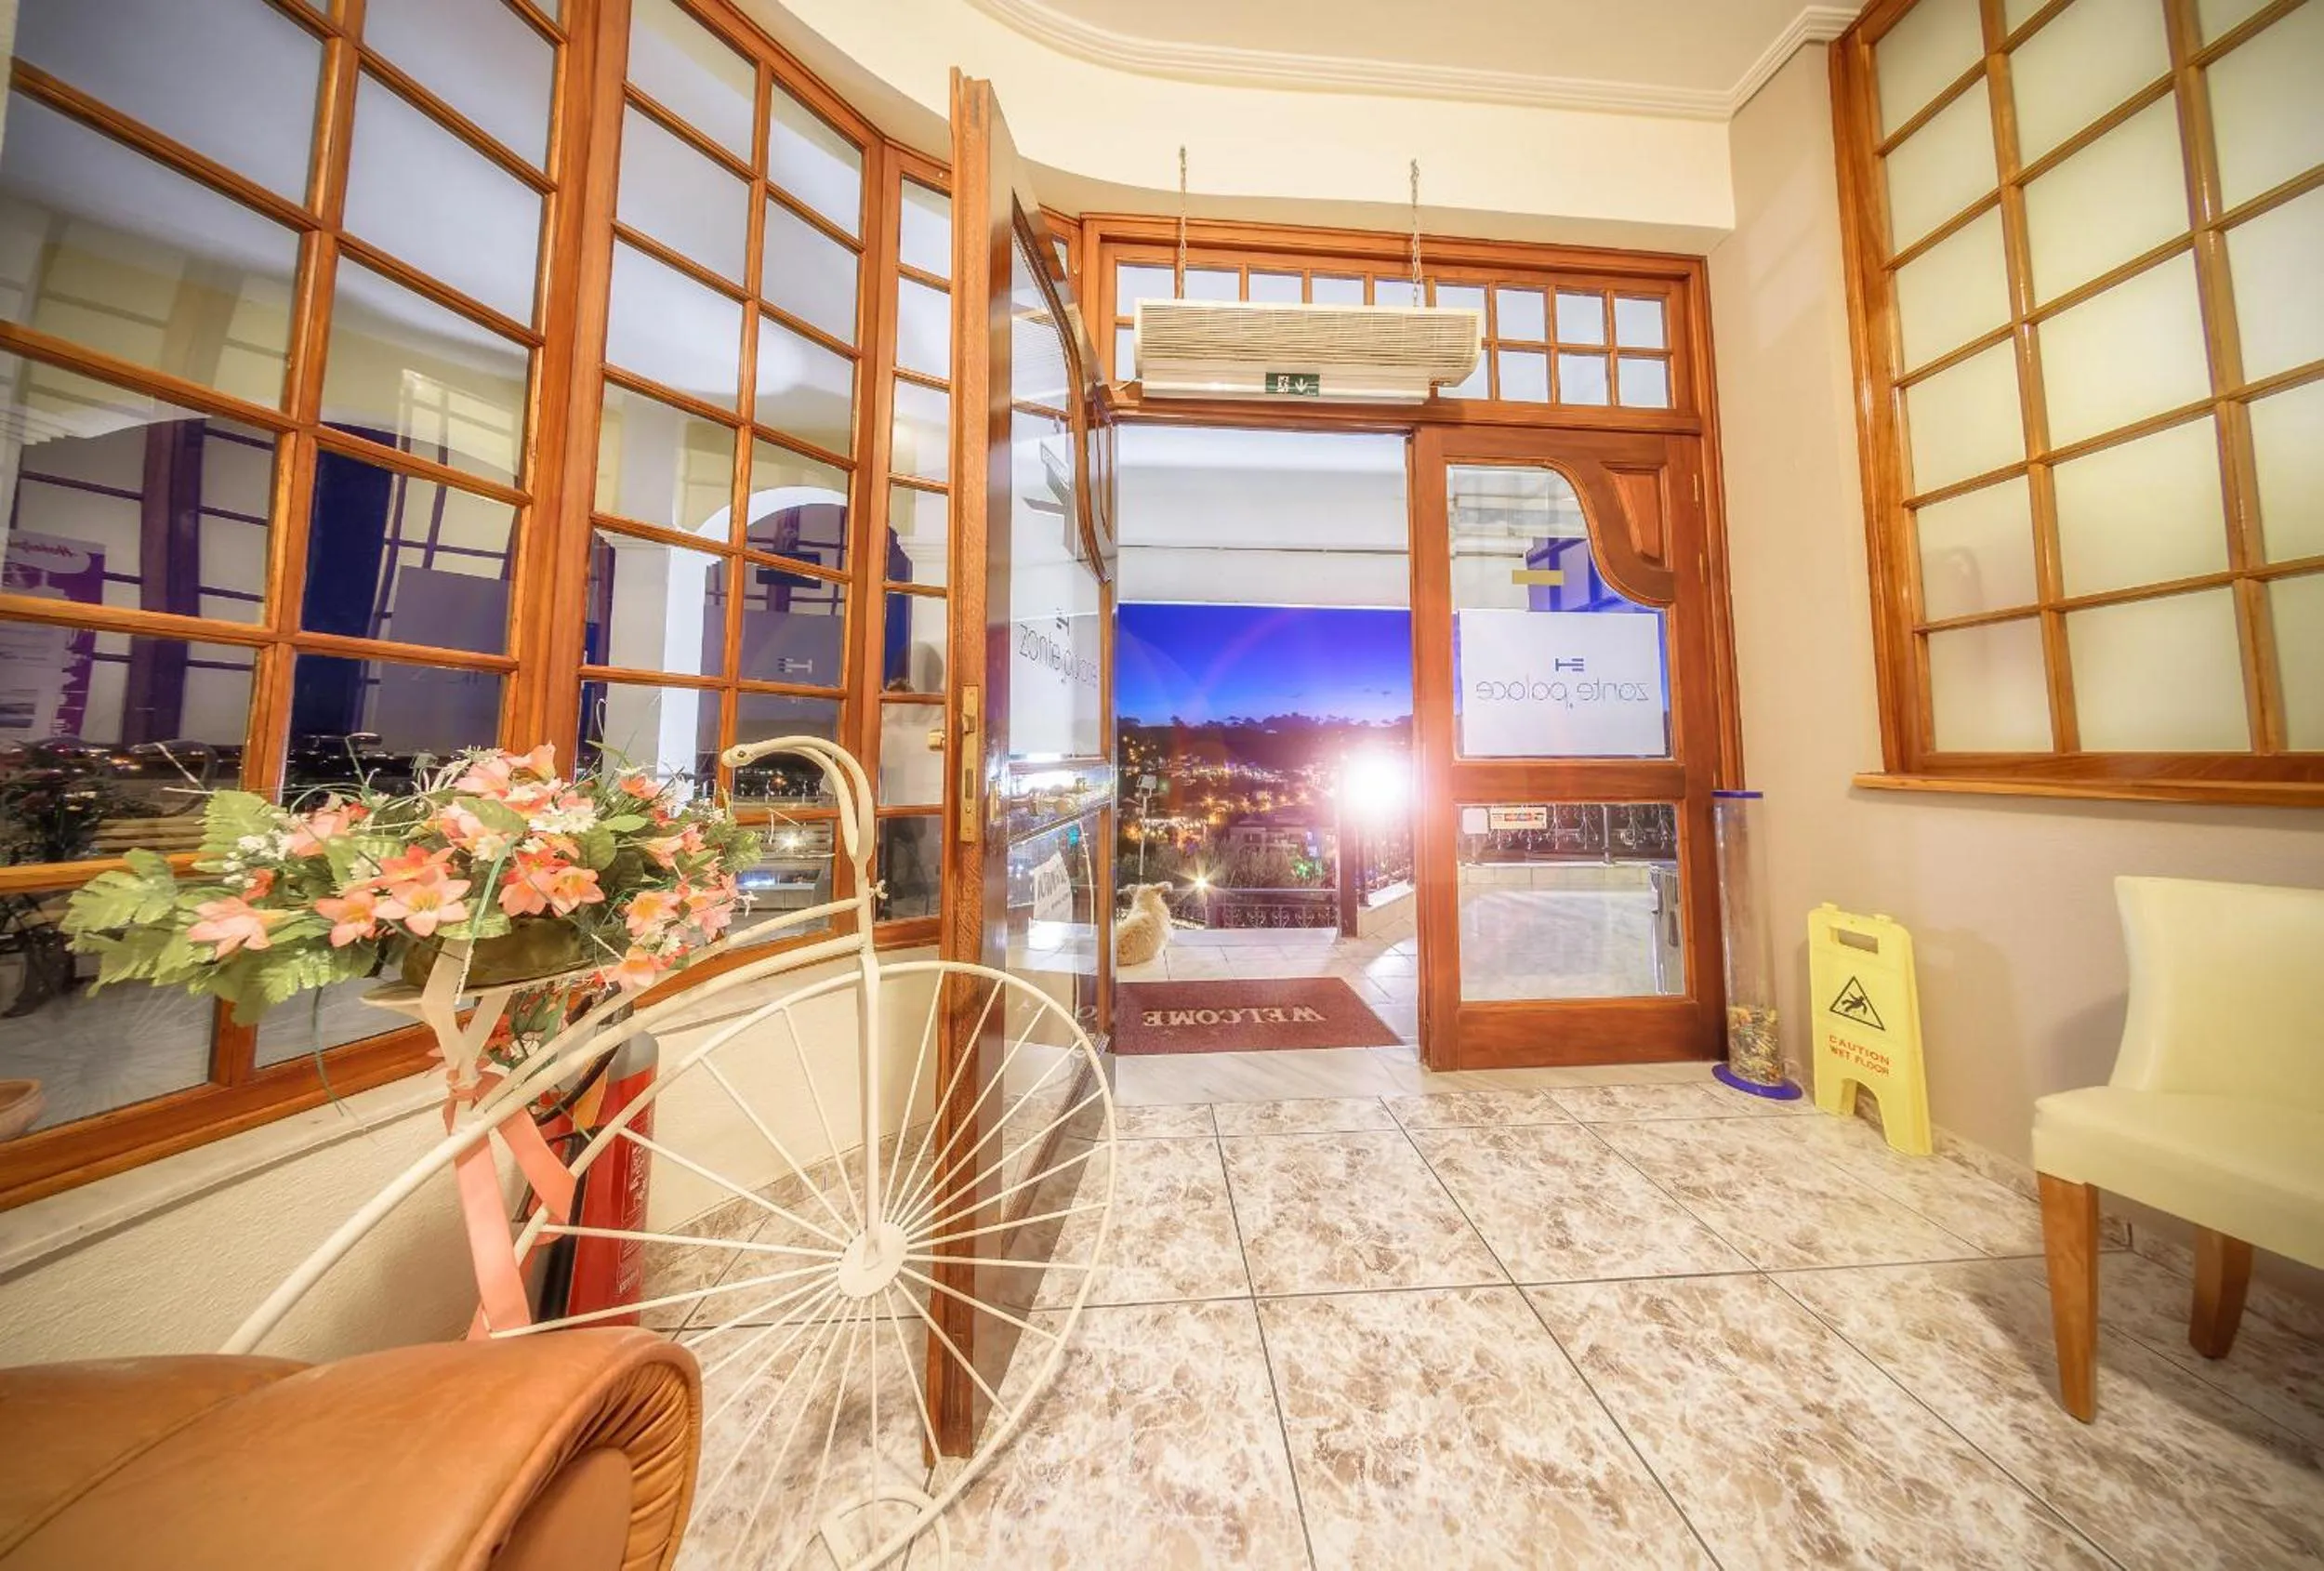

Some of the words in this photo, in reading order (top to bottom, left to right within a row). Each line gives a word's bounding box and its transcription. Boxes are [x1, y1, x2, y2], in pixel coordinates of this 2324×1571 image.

[1142, 1005, 1327, 1026] WELCOME
[1829, 1035, 1890, 1066] CAUTION
[1855, 1055, 1890, 1075] FLOOR
